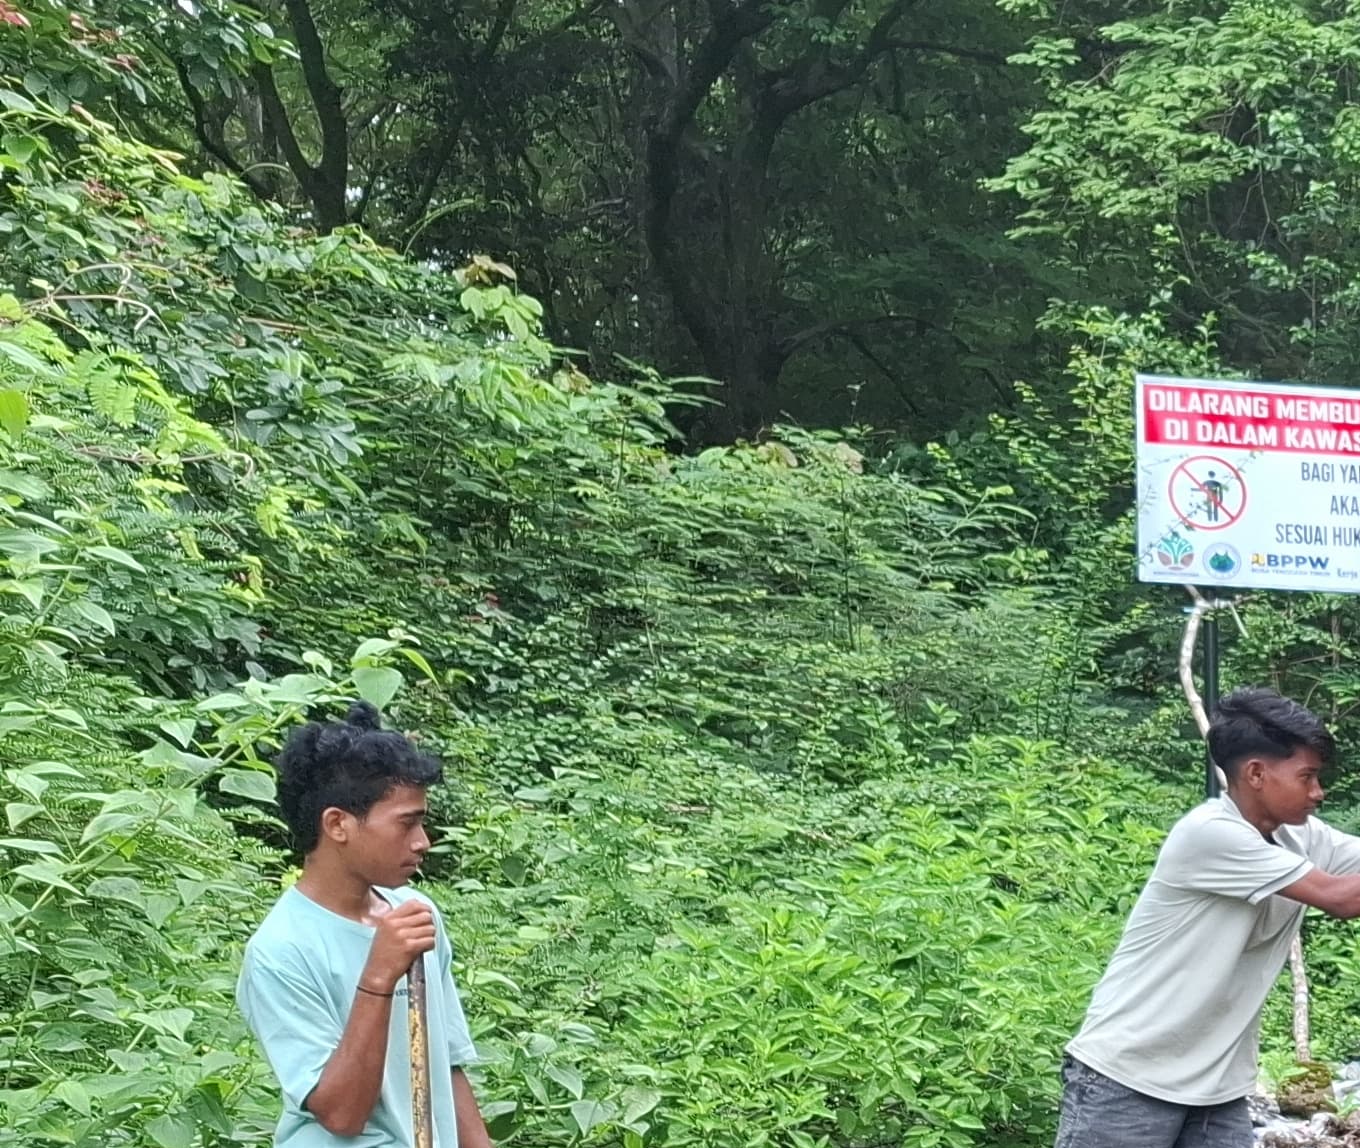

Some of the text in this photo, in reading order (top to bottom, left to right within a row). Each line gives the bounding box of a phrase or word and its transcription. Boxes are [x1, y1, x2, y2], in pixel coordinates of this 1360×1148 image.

[1149, 389, 1269, 418] DILARANG
[1165, 418, 1189, 441] DI
[1196, 420, 1277, 447] DALAM
[1301, 462, 1335, 483] BAGI
[1275, 523, 1328, 546] SESUAI
[1266, 553, 1330, 569] BPPW
